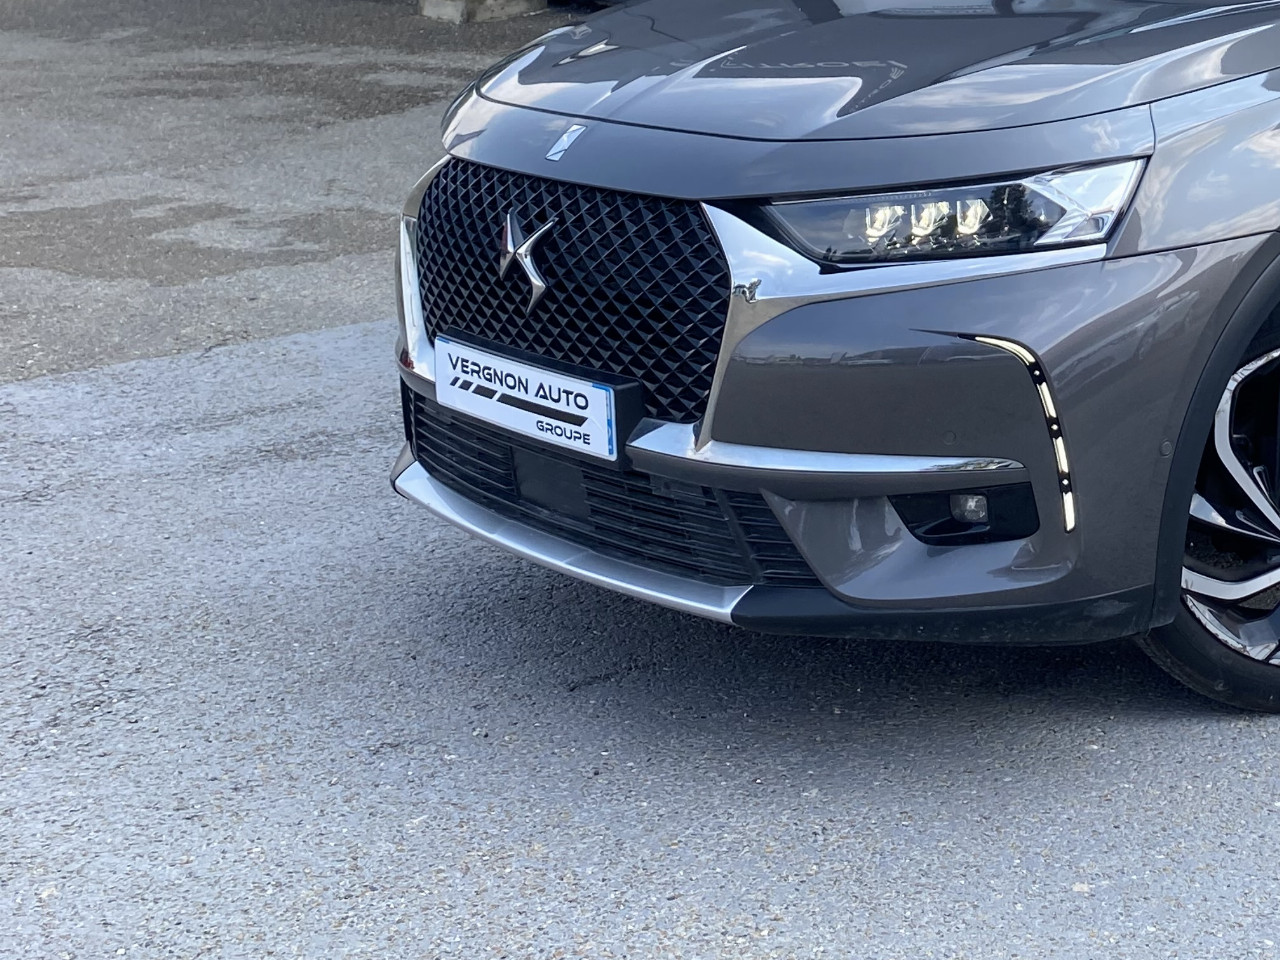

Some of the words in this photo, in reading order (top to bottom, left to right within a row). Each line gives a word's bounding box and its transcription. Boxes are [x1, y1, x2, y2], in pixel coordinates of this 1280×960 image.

[447, 352, 529, 395] VERGNON
[534, 382, 589, 411] AUTO
[536, 420, 591, 446] GROUPE
